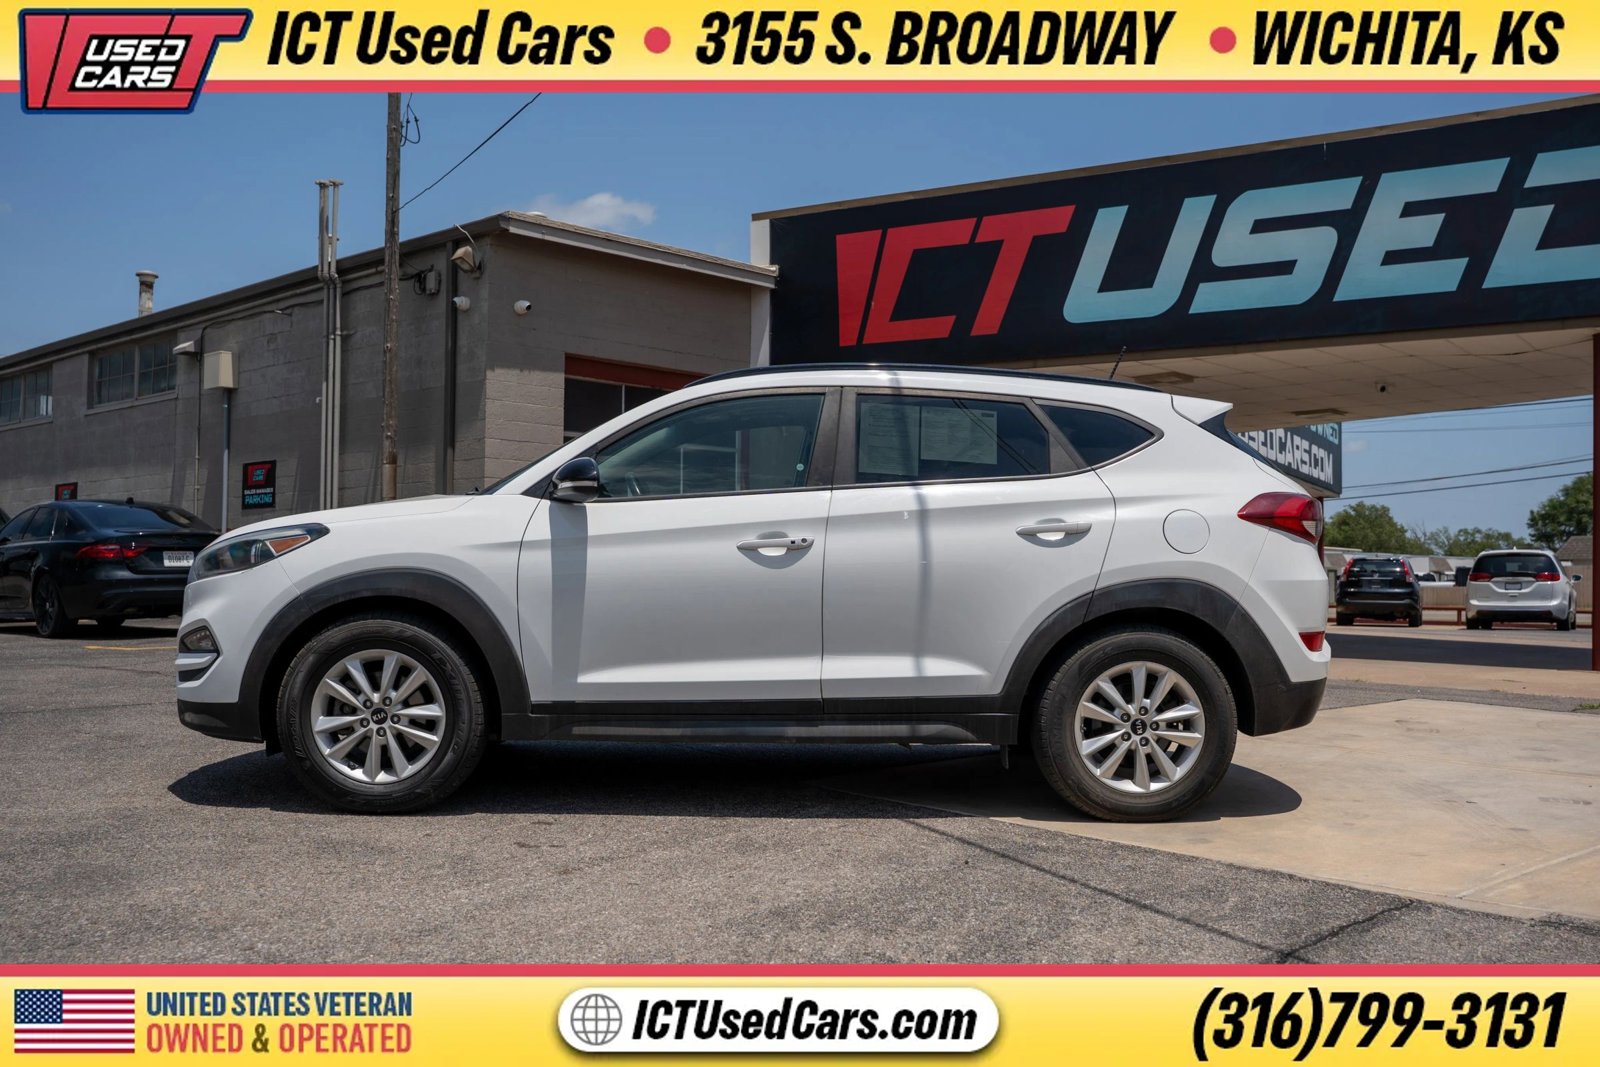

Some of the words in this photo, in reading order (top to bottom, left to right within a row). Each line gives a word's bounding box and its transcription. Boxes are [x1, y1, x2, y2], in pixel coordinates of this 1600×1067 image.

[836, 204, 1076, 347] ICT
[244, 494, 273, 504] PARKING
[372, 711, 387, 721] KIA
[1135, 719, 1144, 735] KIA
